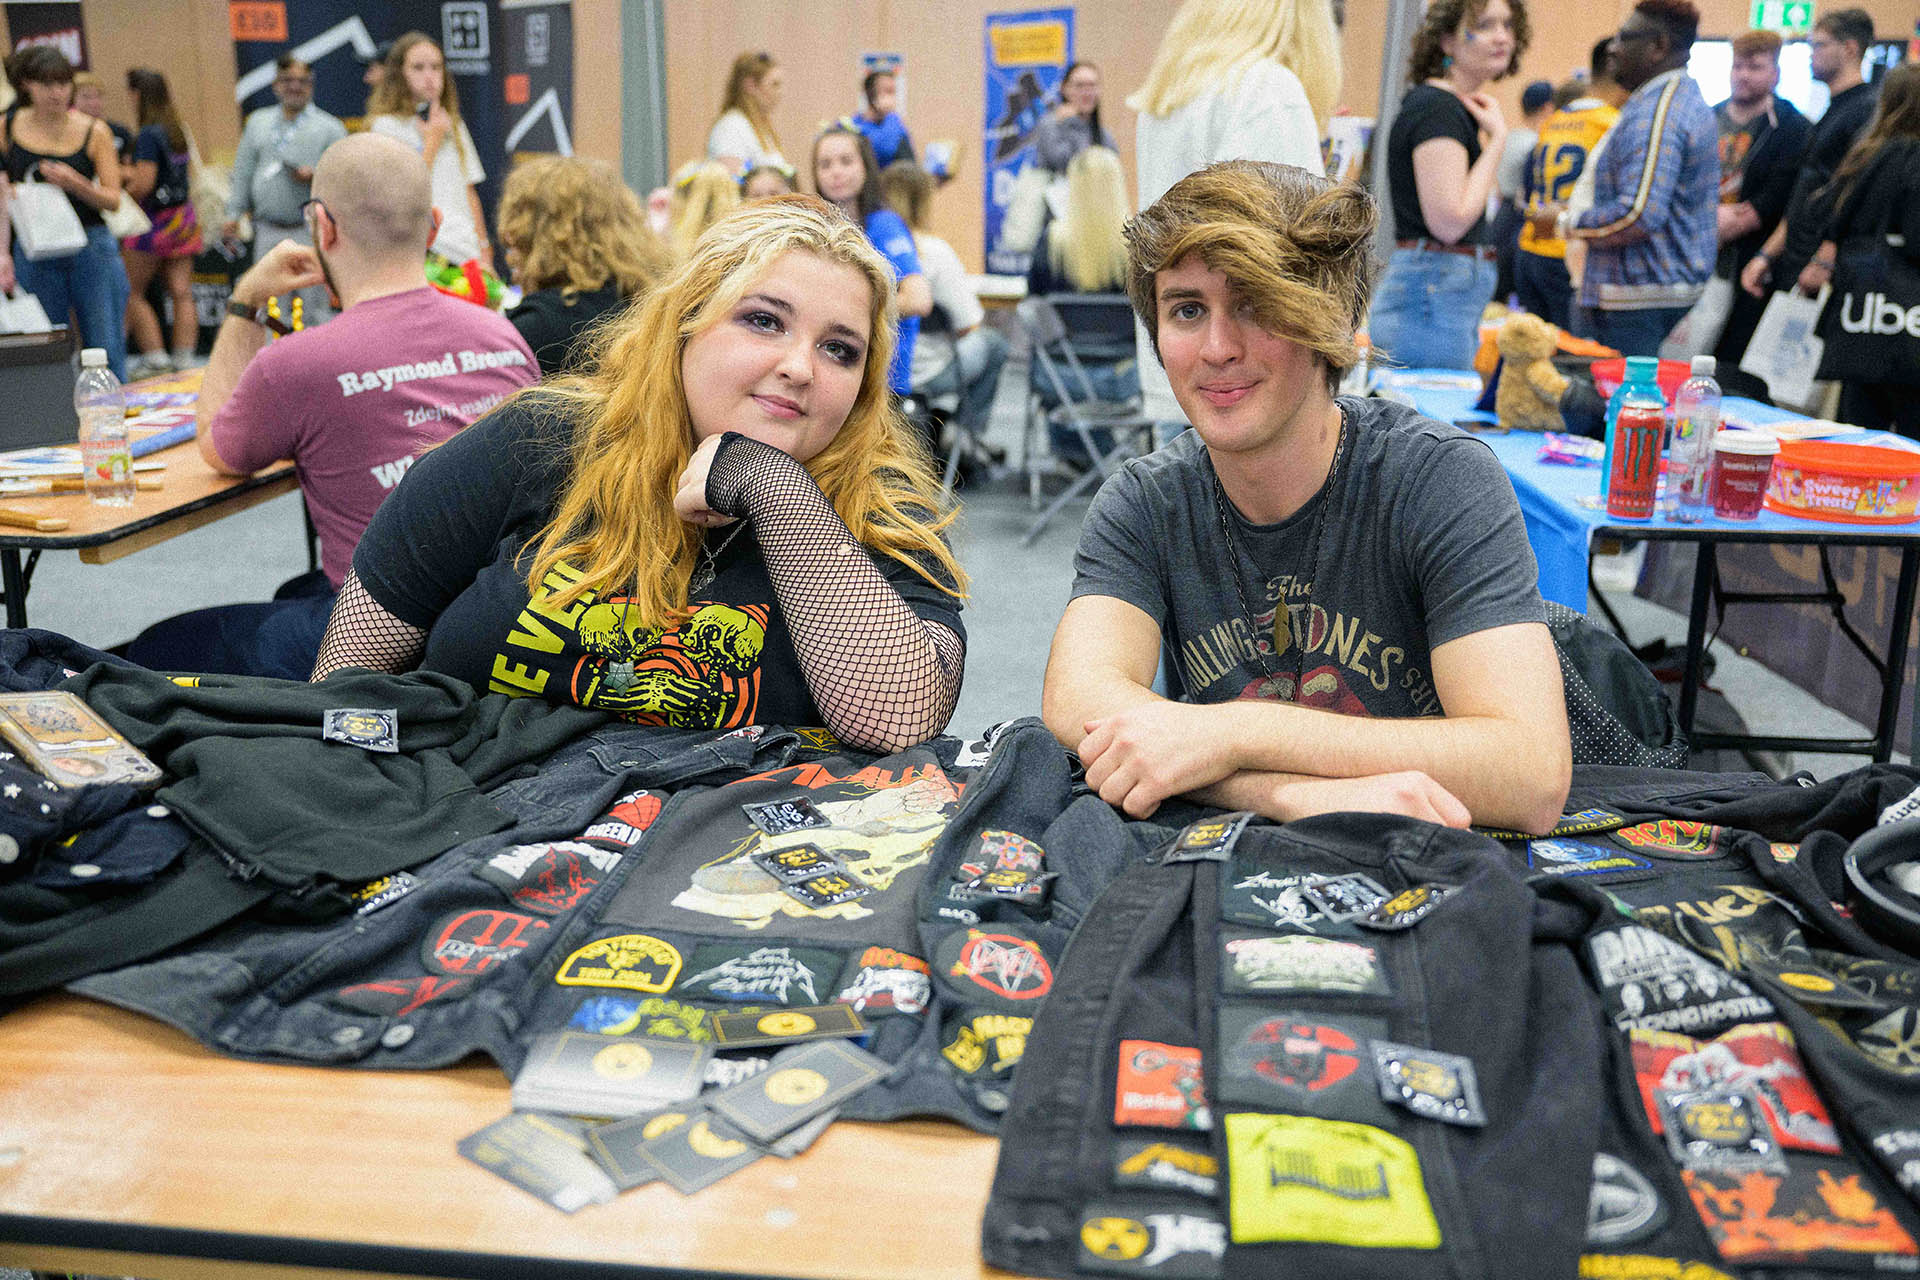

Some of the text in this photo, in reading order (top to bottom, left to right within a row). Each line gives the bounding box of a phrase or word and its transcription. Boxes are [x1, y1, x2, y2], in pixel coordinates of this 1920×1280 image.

[337, 349, 528, 397] Raymond Brown
[1265, 575, 1314, 601] The
[584, 822, 630, 844] GREEN
